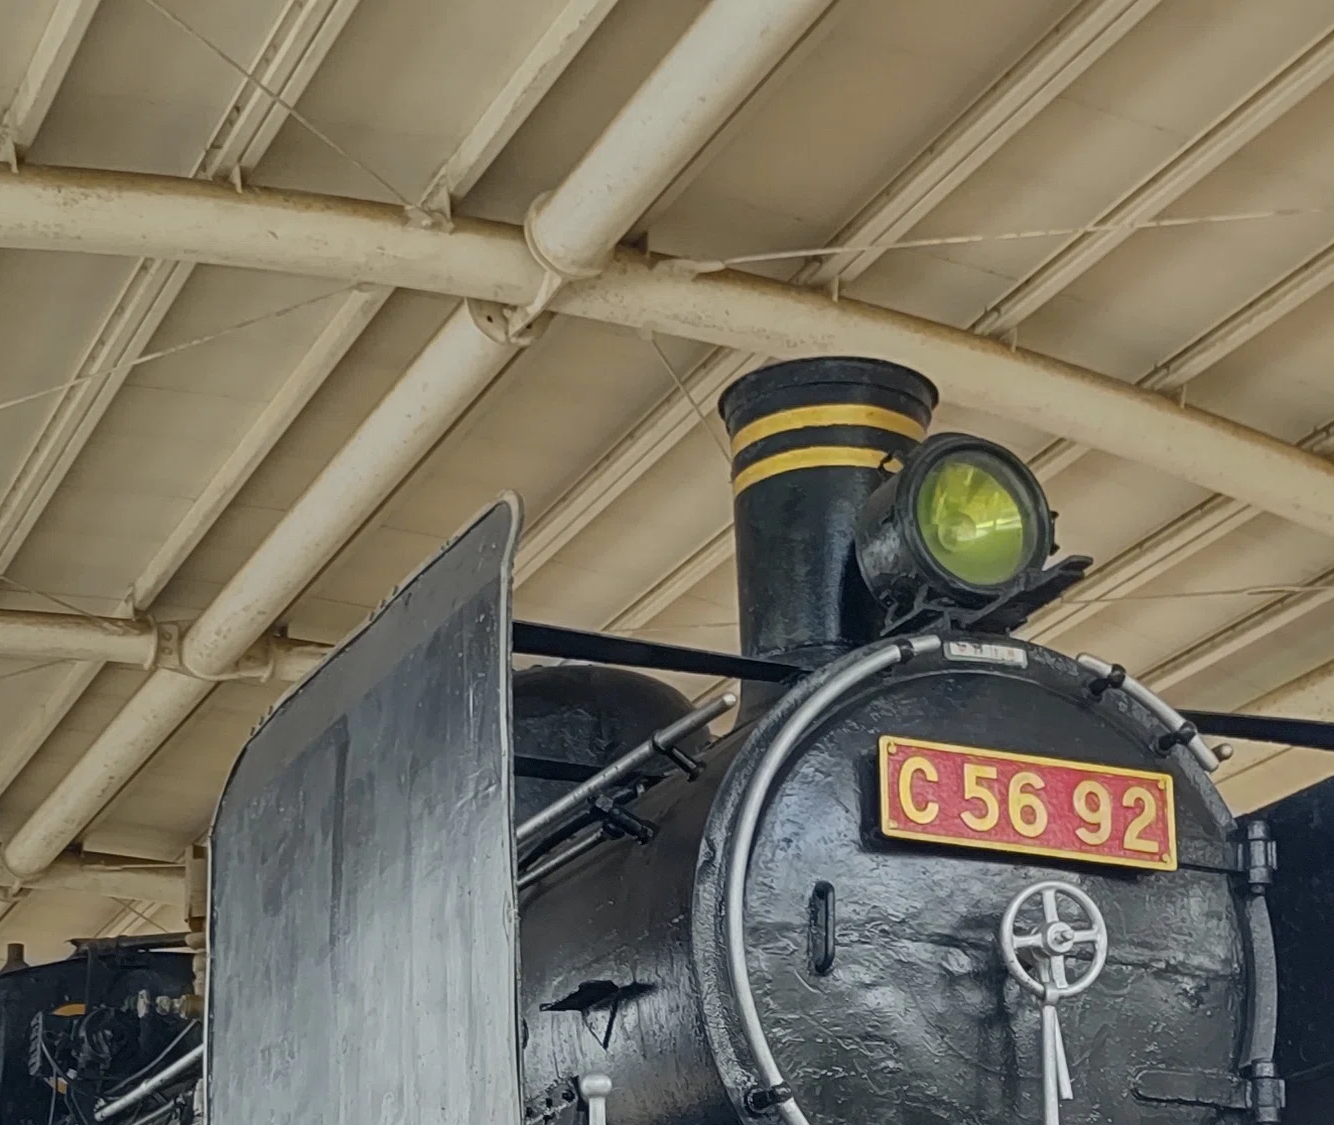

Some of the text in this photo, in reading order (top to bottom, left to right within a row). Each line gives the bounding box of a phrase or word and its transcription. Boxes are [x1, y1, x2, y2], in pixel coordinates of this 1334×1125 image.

[898, 756, 1160, 853] C 56 92
